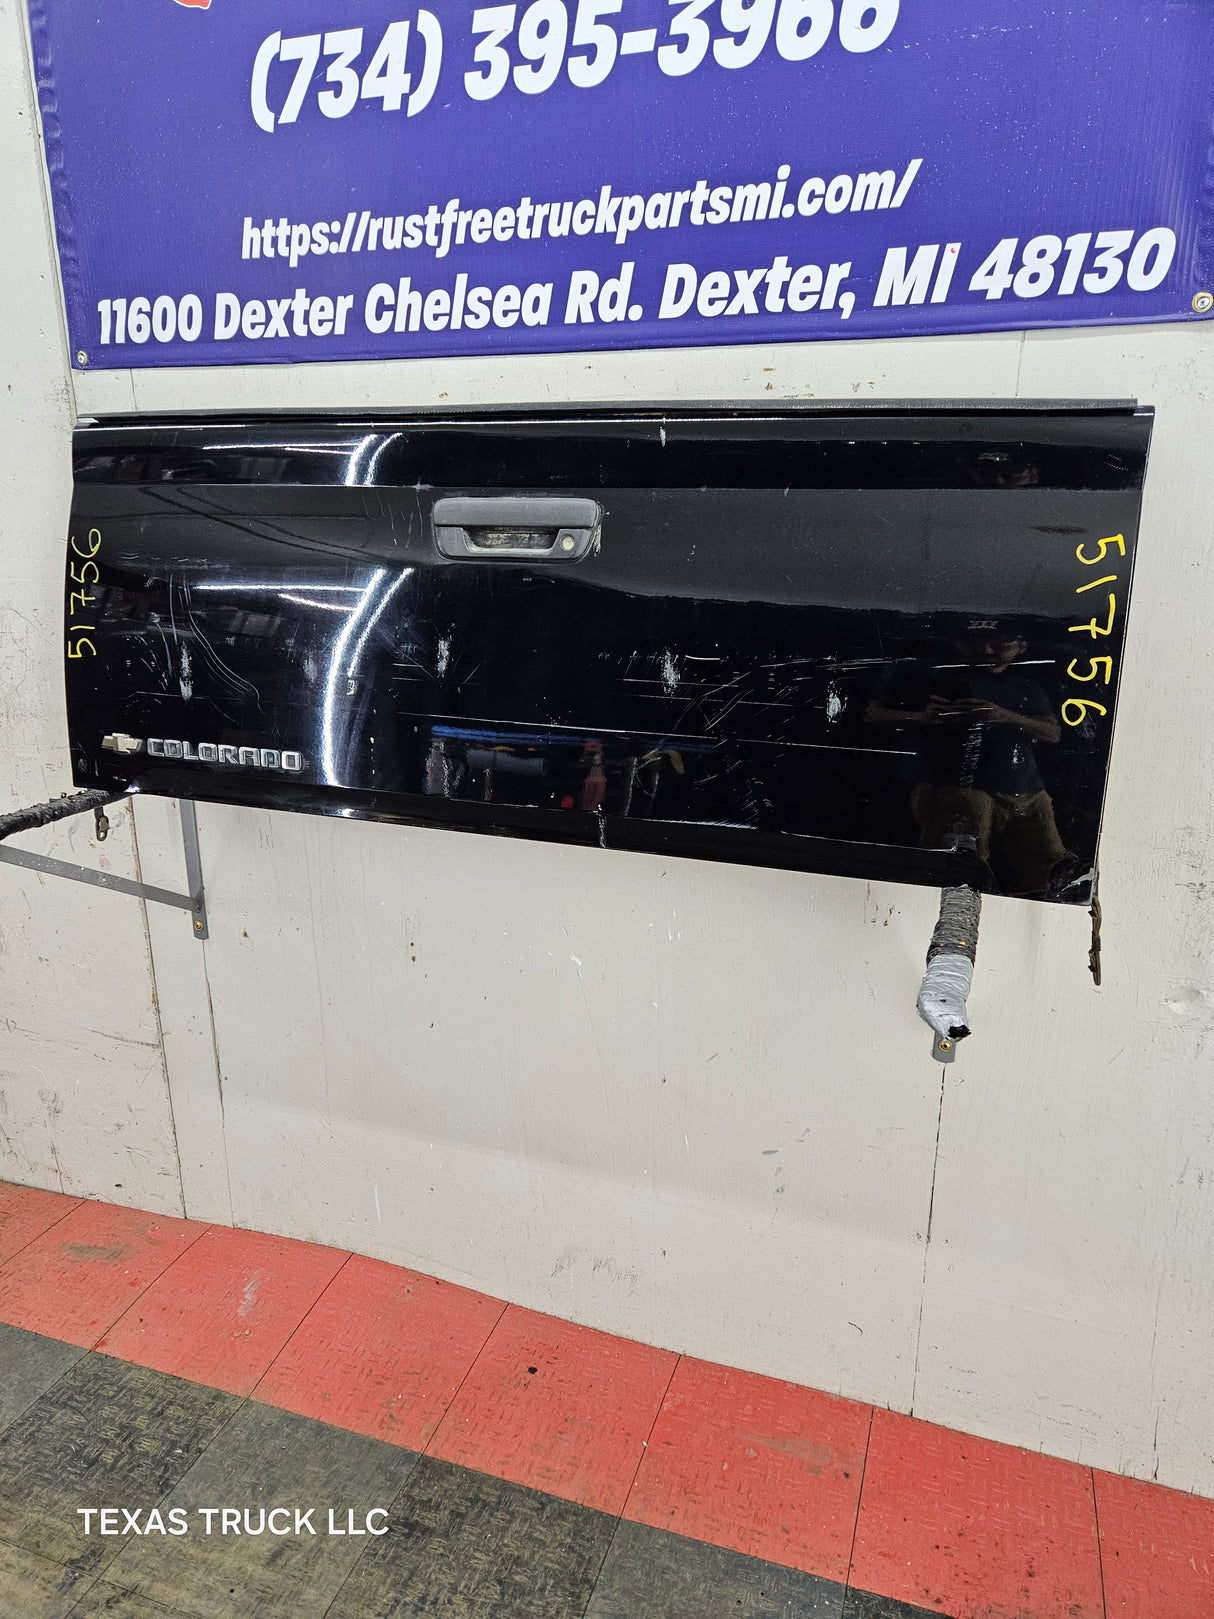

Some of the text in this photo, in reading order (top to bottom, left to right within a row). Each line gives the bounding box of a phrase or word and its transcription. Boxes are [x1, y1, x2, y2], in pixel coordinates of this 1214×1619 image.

[250, 9, 443, 134] (734)
[241, 158, 924, 268] https://rustfreetruckpartsmi.com/
[97, 227, 1177, 345] 11600 Dexter Chelsea Rd. Dexter, MI 48130
[67, 528, 102, 659] 51756
[1061, 533, 1126, 727] 51756
[147, 738, 303, 771] COLORADO
